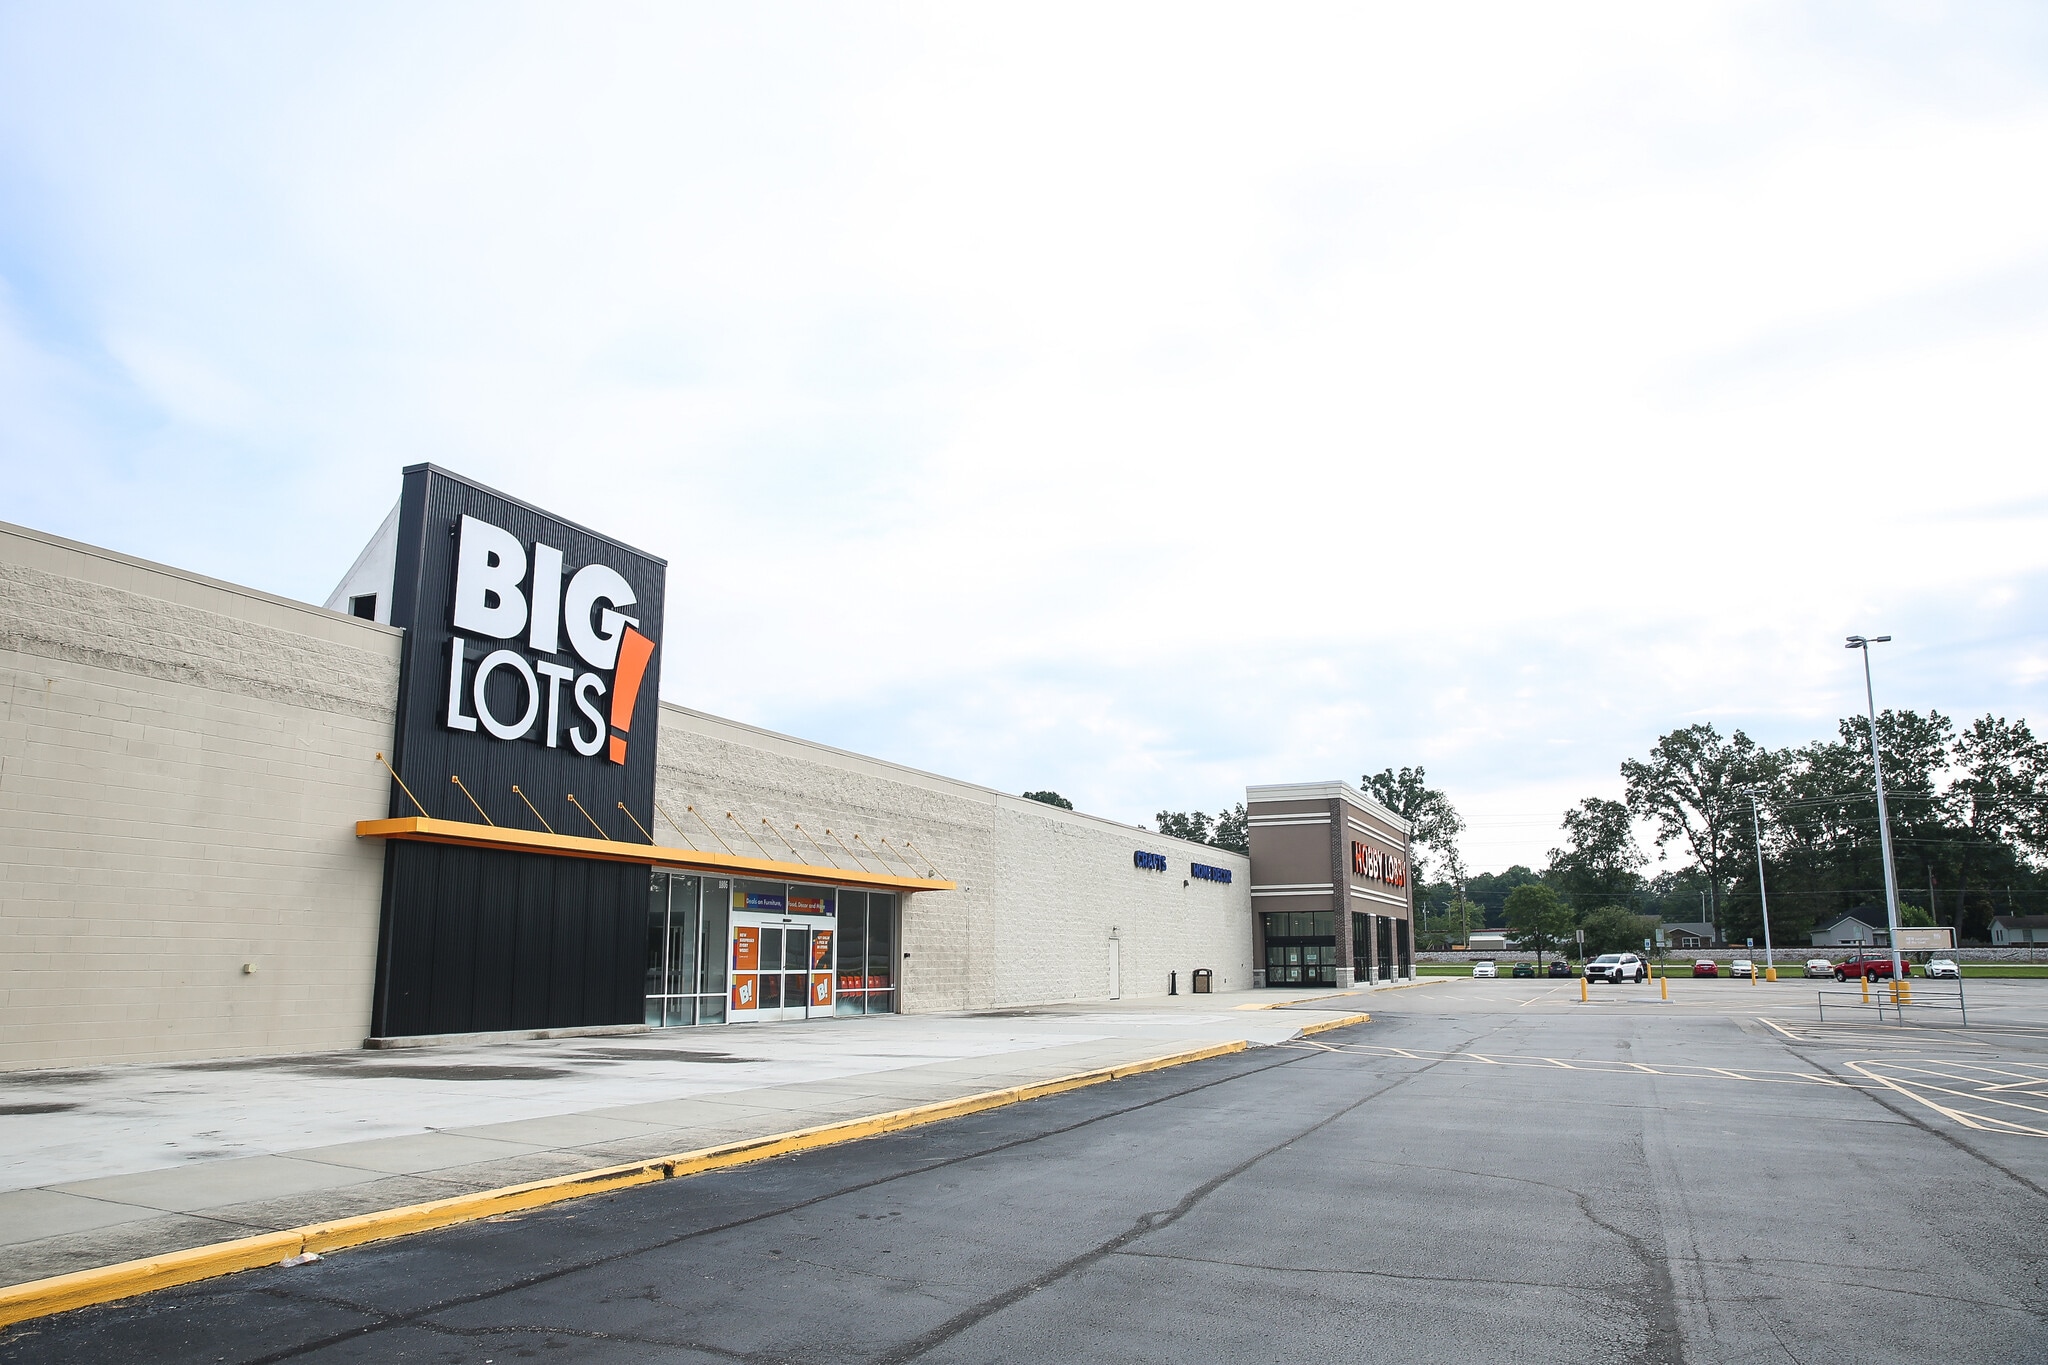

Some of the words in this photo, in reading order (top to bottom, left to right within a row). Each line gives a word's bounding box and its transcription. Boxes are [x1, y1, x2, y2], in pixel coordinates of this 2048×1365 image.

[454, 513, 640, 670] BIG
[1135, 850, 1167, 872] CRAFTS
[1192, 862, 1213, 881] HOME
[1212, 866, 1233, 884] DECOR
[1353, 841, 1383, 880] HOBBY
[1383, 853, 1406, 888] LOBBY
